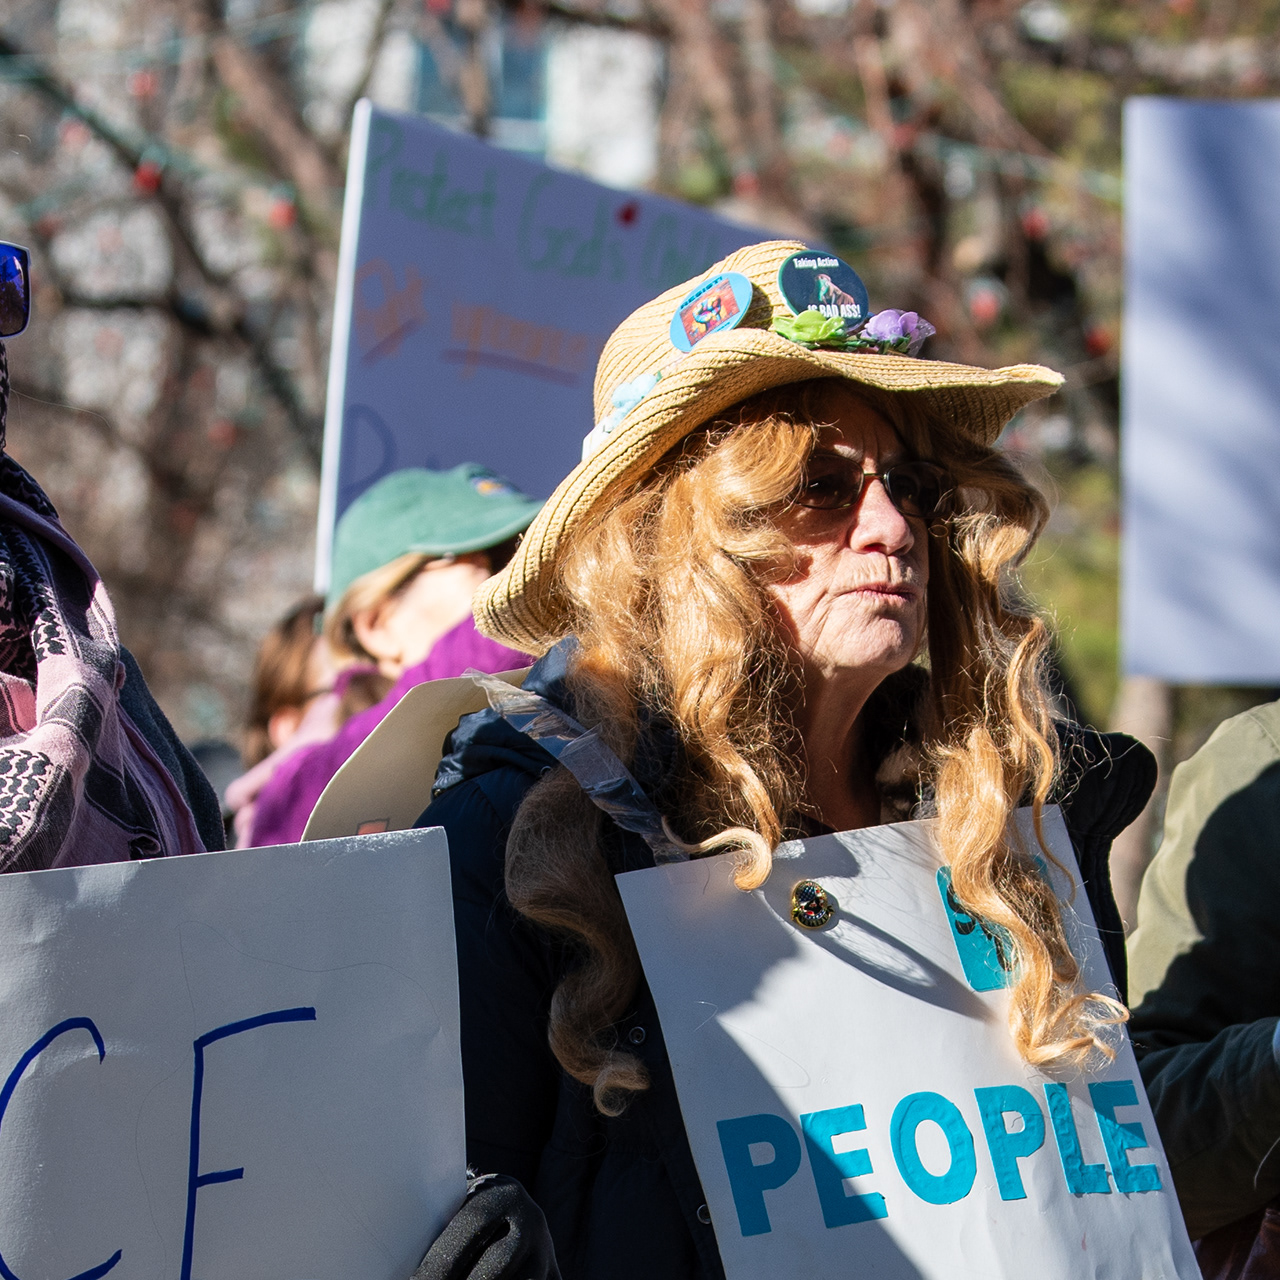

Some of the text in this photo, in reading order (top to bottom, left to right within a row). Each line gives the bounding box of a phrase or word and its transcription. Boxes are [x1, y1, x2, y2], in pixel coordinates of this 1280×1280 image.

[793, 256, 839, 269] Taking Action
[681, 276, 723, 310] RESIST!
[819, 304, 839, 318] BAD
[840, 304, 862, 318] ASS!
[716, 1080, 1163, 1237] PEOPLE
